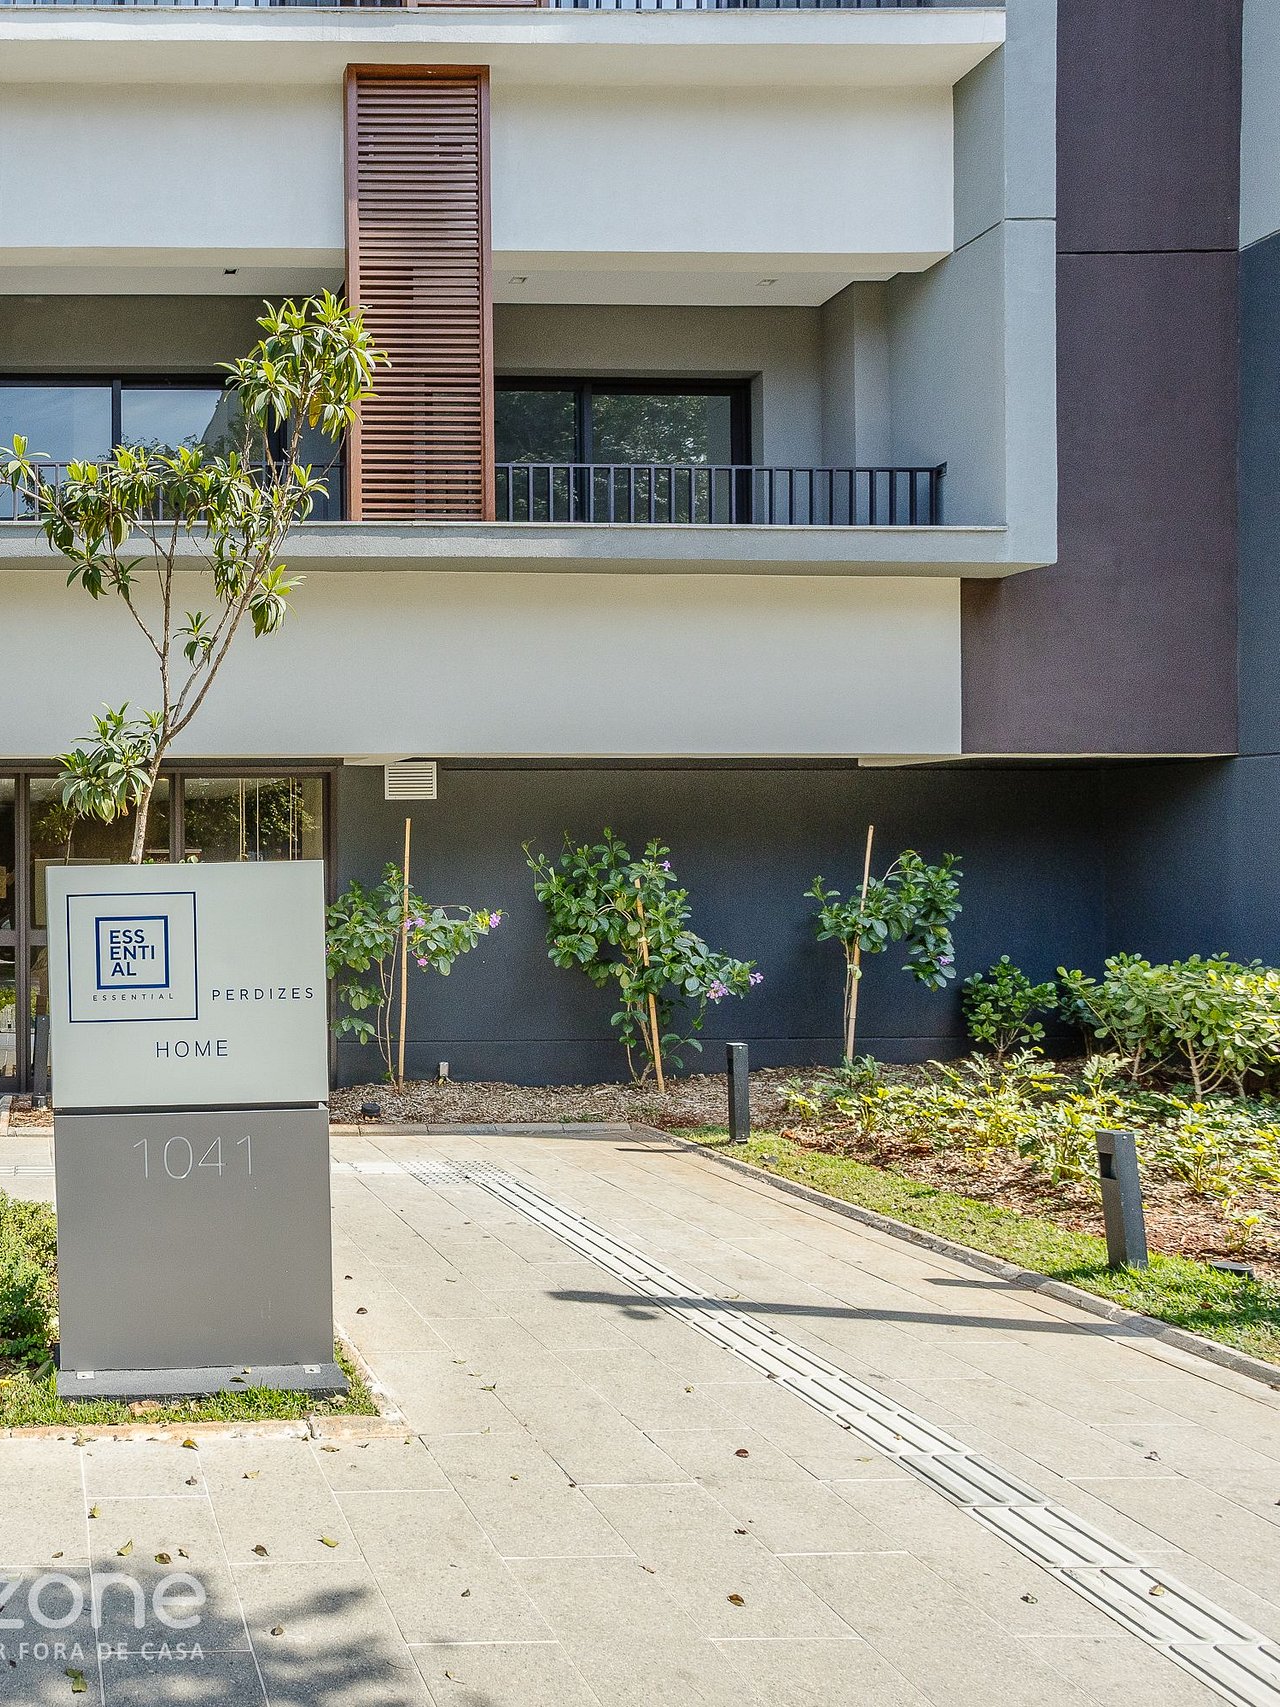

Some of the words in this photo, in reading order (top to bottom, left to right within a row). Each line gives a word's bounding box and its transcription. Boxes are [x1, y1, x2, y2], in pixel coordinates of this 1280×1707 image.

[109, 928, 145, 945] ESS
[110, 944, 156, 961] ENTI
[110, 961, 137, 977] AL
[92, 992, 175, 1002] ESSENTIAL
[211, 987, 315, 1001] PERDIZES
[155, 1039, 229, 1058] HOME
[132, 1135, 252, 1179] 1041
